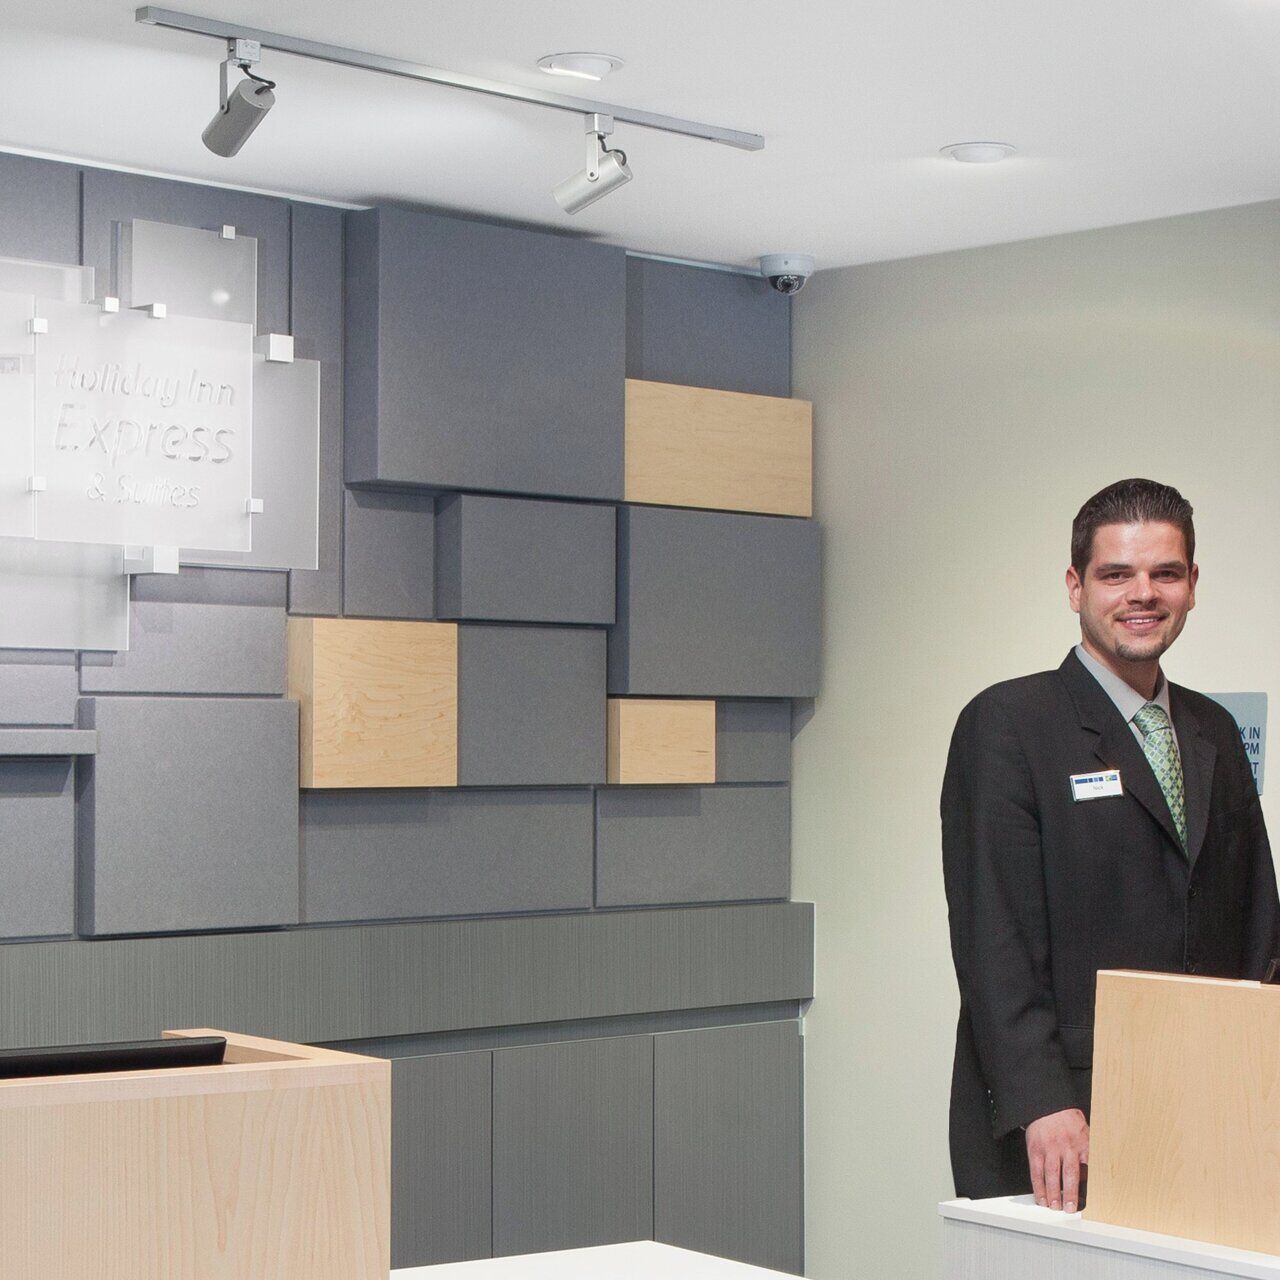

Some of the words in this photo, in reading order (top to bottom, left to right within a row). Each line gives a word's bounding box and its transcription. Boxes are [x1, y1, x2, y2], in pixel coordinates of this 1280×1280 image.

[54, 355, 180, 408] Holiday
[188, 369, 235, 406] Inn
[55, 403, 235, 468] Express
[86, 472, 105, 502] &
[113, 474, 200, 508] Suites
